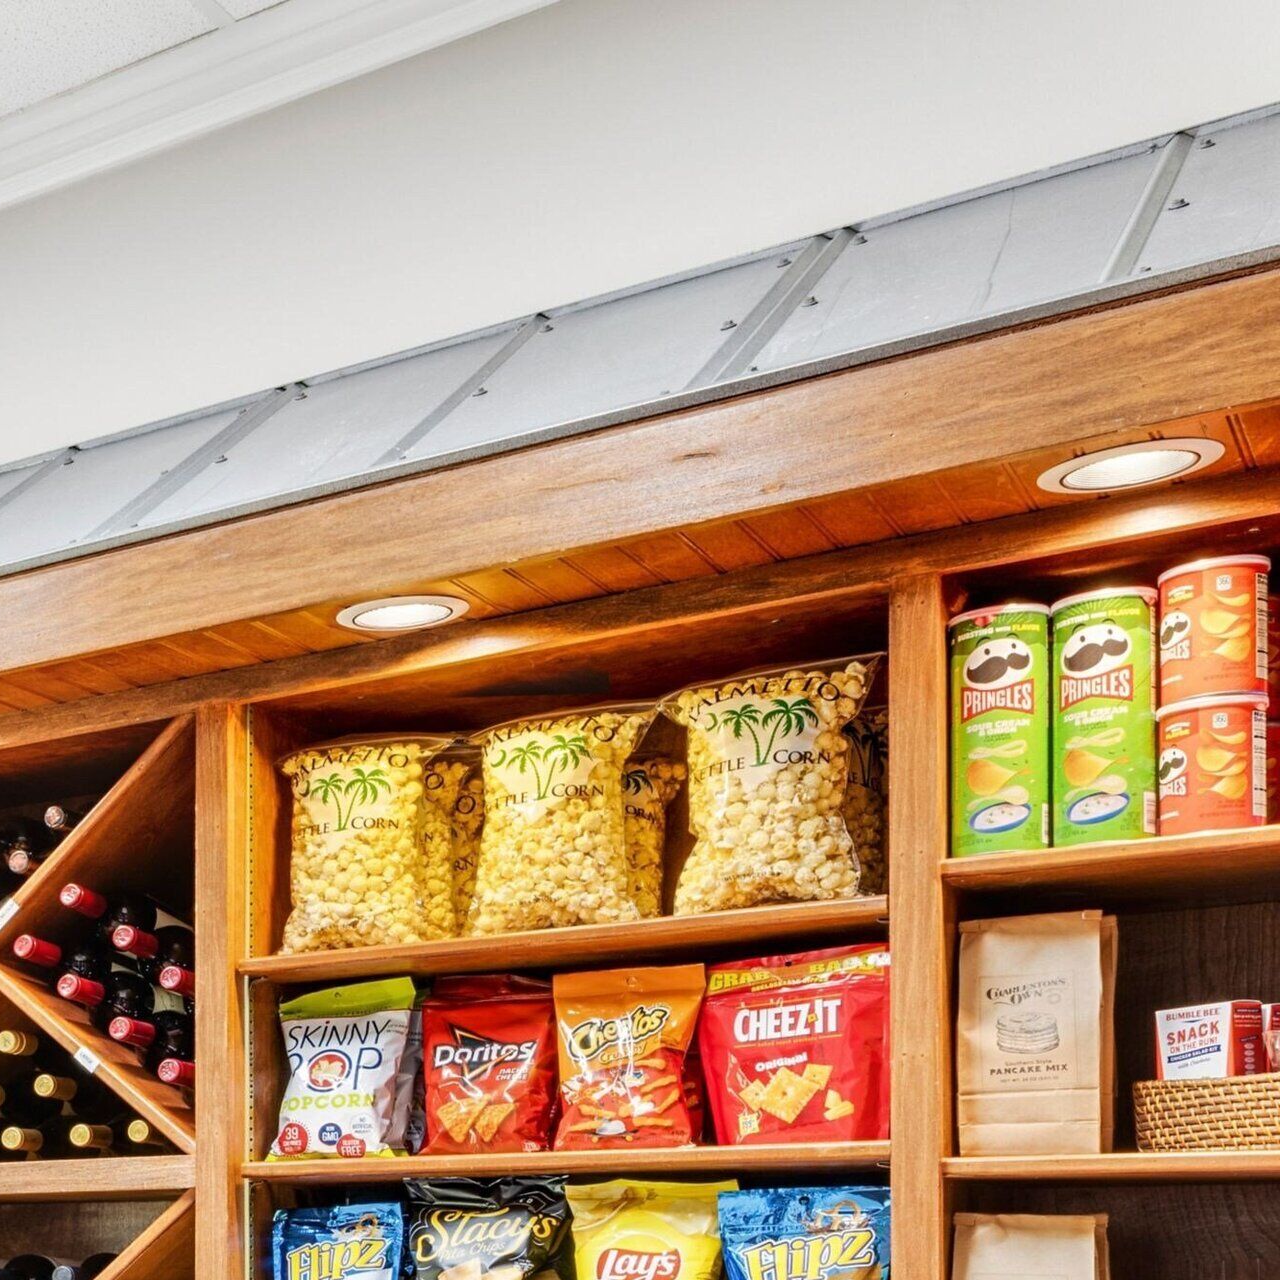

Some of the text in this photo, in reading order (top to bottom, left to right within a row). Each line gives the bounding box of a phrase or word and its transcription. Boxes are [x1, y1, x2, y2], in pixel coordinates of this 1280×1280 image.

[1060, 666, 1131, 707] PRINGLES
[963, 682, 1033, 719] PRINGLES
[773, 749, 831, 765] CORN
[551, 782, 604, 799] CORN
[351, 816, 399, 831] CORN
[1166, 1008, 1220, 1021] BUMBLE BEE
[1167, 1020, 1220, 1046] SNACK
[434, 1039, 539, 1068] Doritos
[990, 1063, 1068, 1076] PANCAKE MIX
[284, 1126, 299, 1140] 39
[321, 1132, 339, 1142] GMO
[341, 1146, 363, 1157] FREE
[416, 1207, 559, 1262] Stacy's
[470, 1241, 506, 1257] Chips
